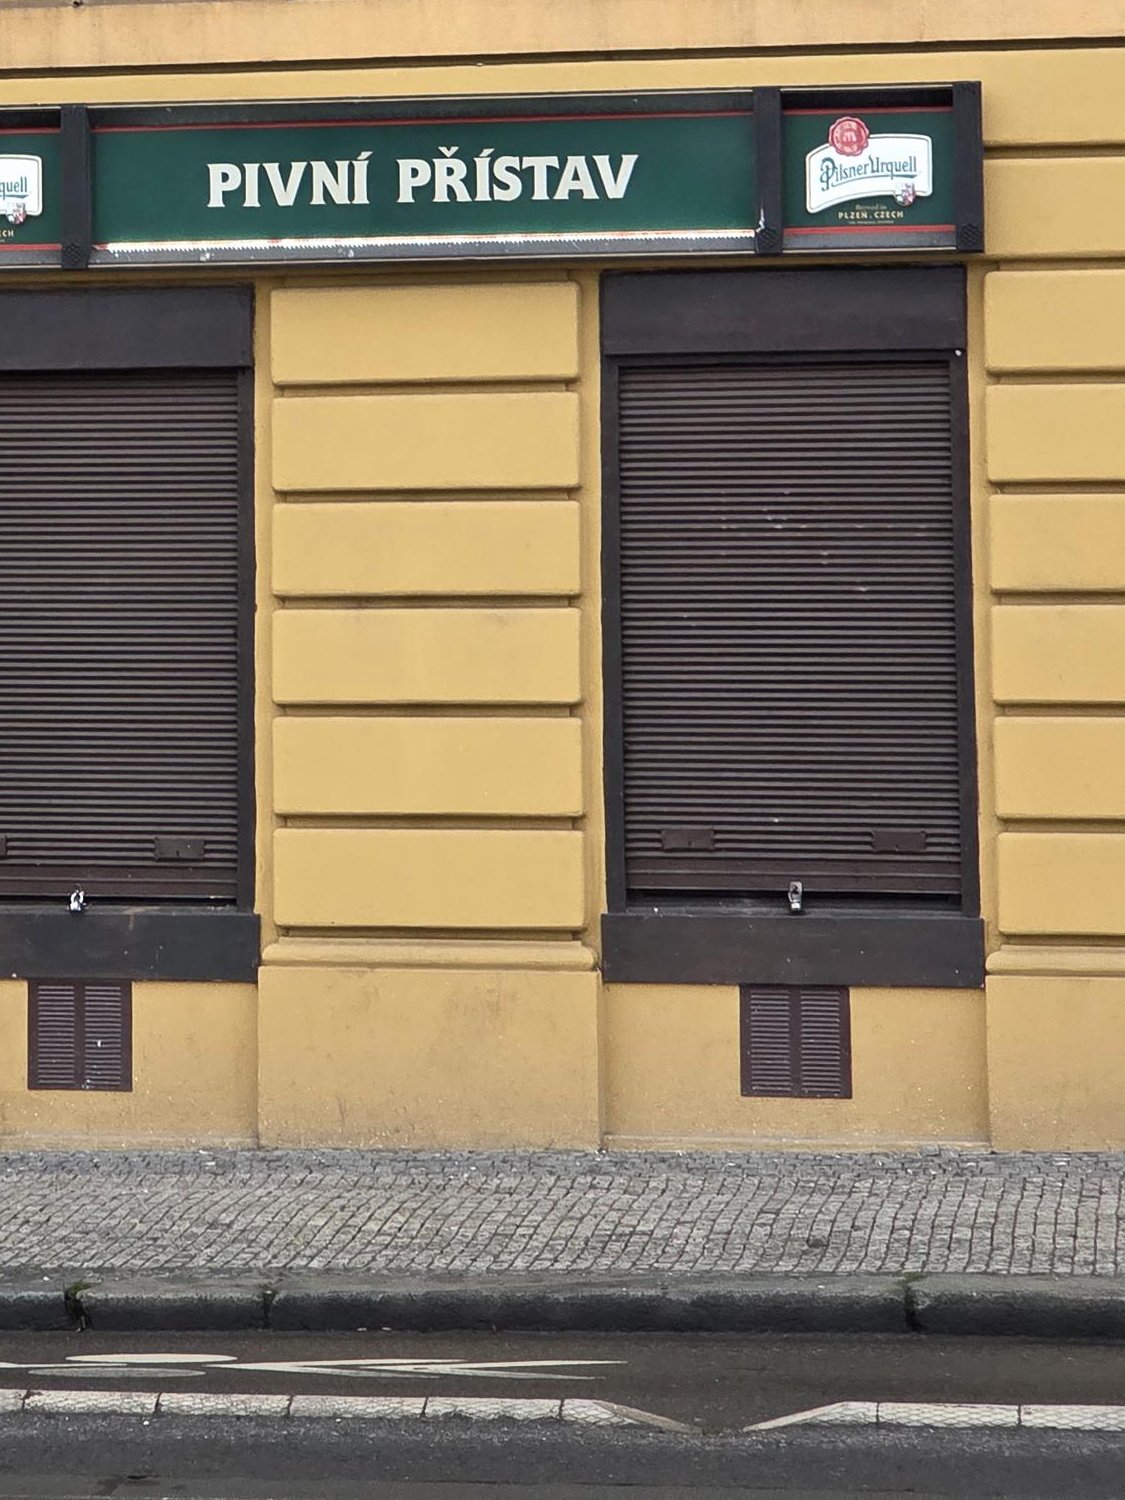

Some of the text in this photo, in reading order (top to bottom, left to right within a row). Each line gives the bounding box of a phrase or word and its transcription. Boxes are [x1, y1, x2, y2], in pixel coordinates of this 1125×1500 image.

[206, 146, 639, 208] PIVNÍ PŘÍSTAV
[819, 154, 918, 192] Pilsner Urquell
[873, 210, 905, 219] CZECH
